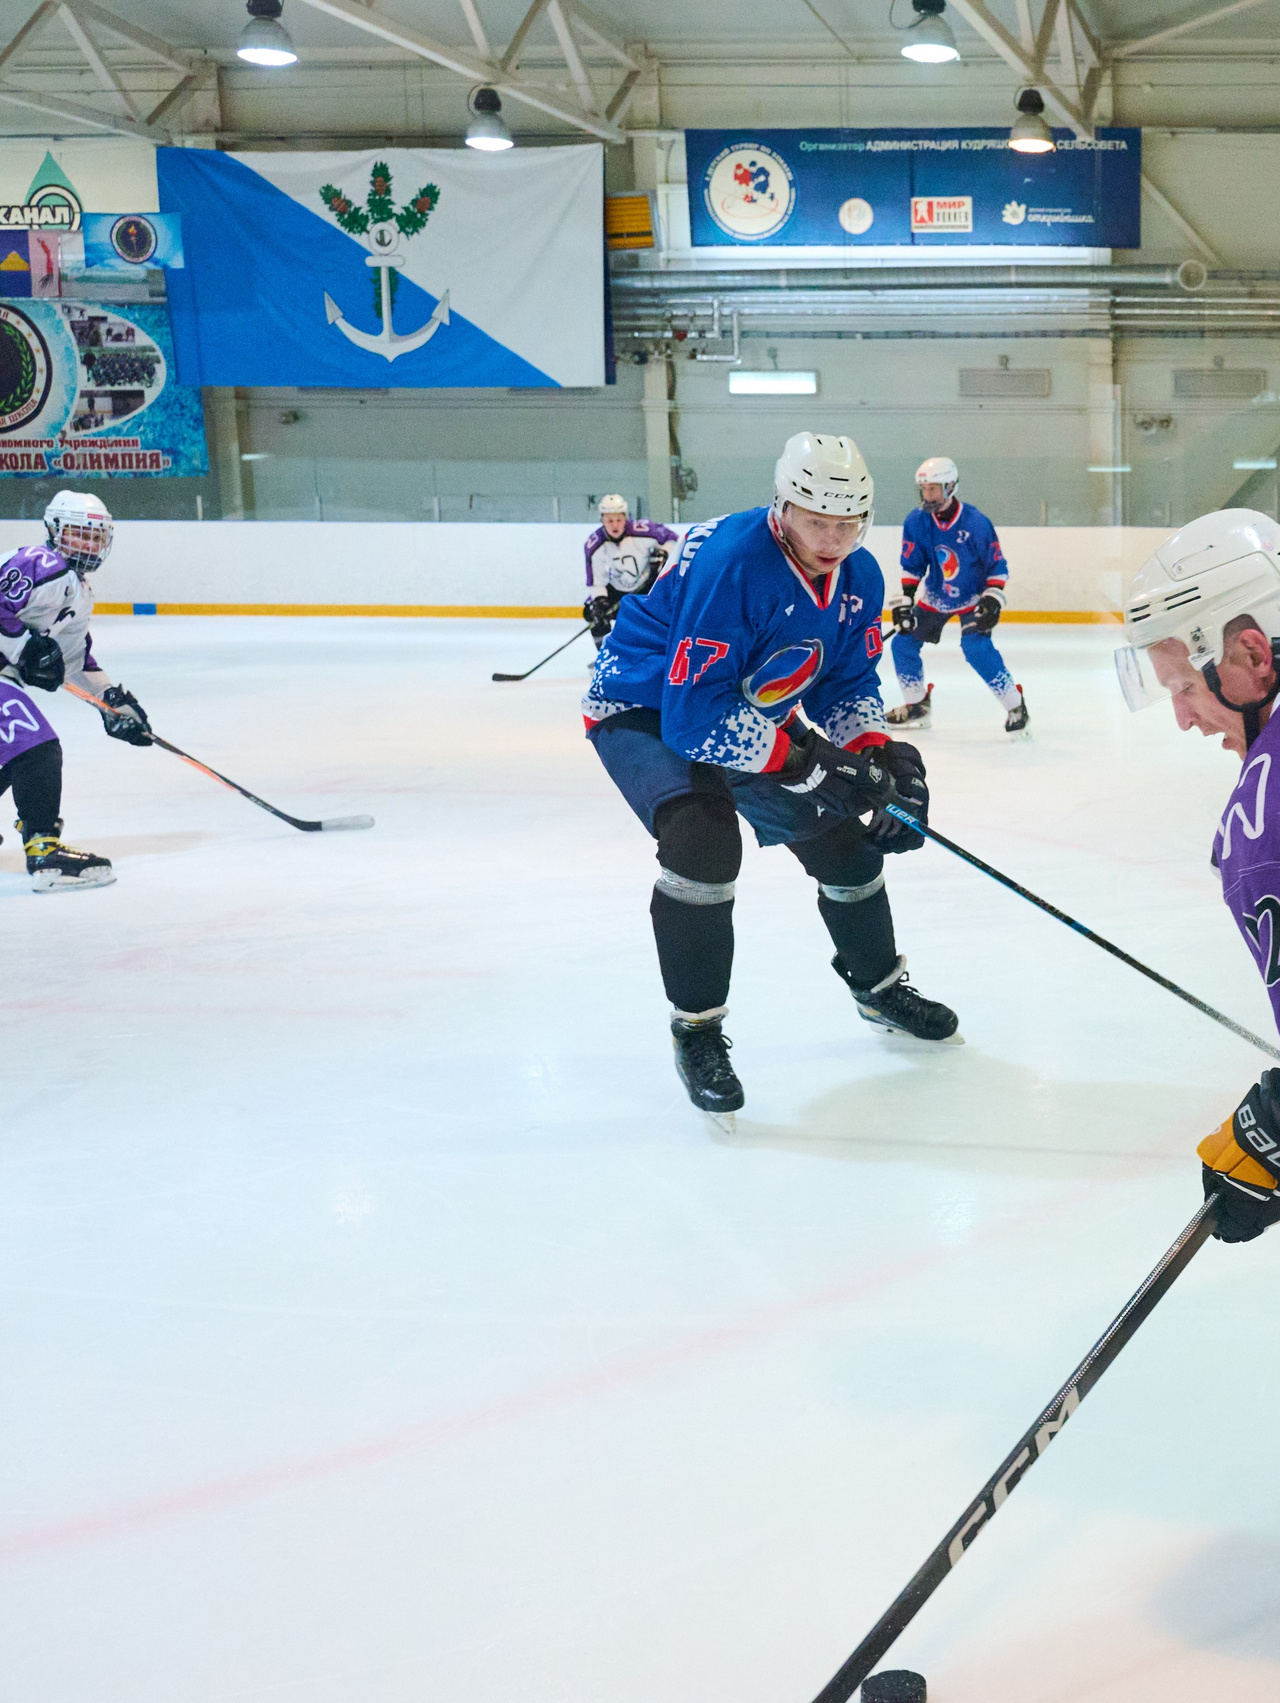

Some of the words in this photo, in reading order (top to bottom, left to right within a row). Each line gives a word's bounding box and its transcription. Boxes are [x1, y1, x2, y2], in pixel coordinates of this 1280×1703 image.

[866, 140, 959, 152] АДМИНИСТРАЦИЯ
[1056, 140, 1128, 150] СЕЛЬСОВЕТА
[823, 491, 855, 499] CCM
[0, 568, 34, 602] 83
